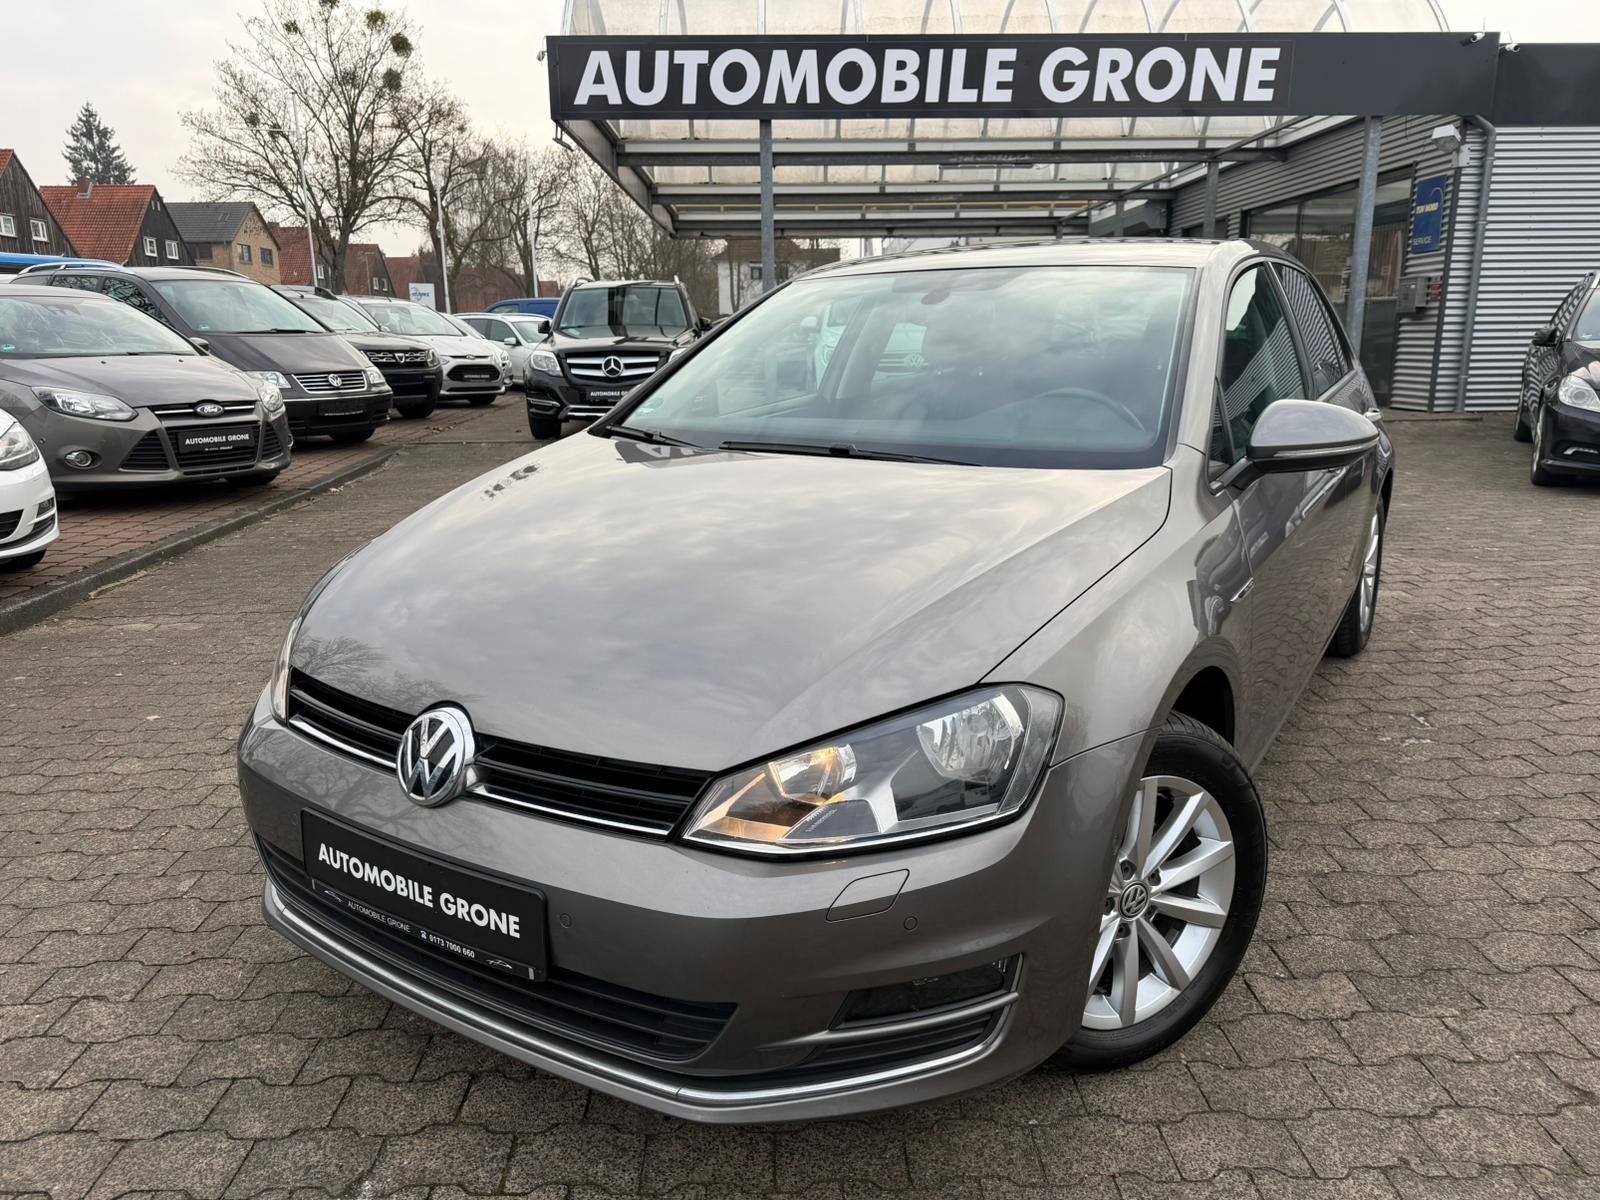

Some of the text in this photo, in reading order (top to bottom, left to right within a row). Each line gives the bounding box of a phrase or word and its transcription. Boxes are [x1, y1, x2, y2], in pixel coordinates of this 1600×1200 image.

[573, 46, 1281, 106] AUTOMOBILE GRONE
[185, 433, 250, 445] AUTOMOBILE GRONE
[318, 843, 521, 938] AUTOMOBILE GRONE
[348, 901, 411, 932] AUTOMOBILE GRONE
[429, 934, 445, 947] 0173
